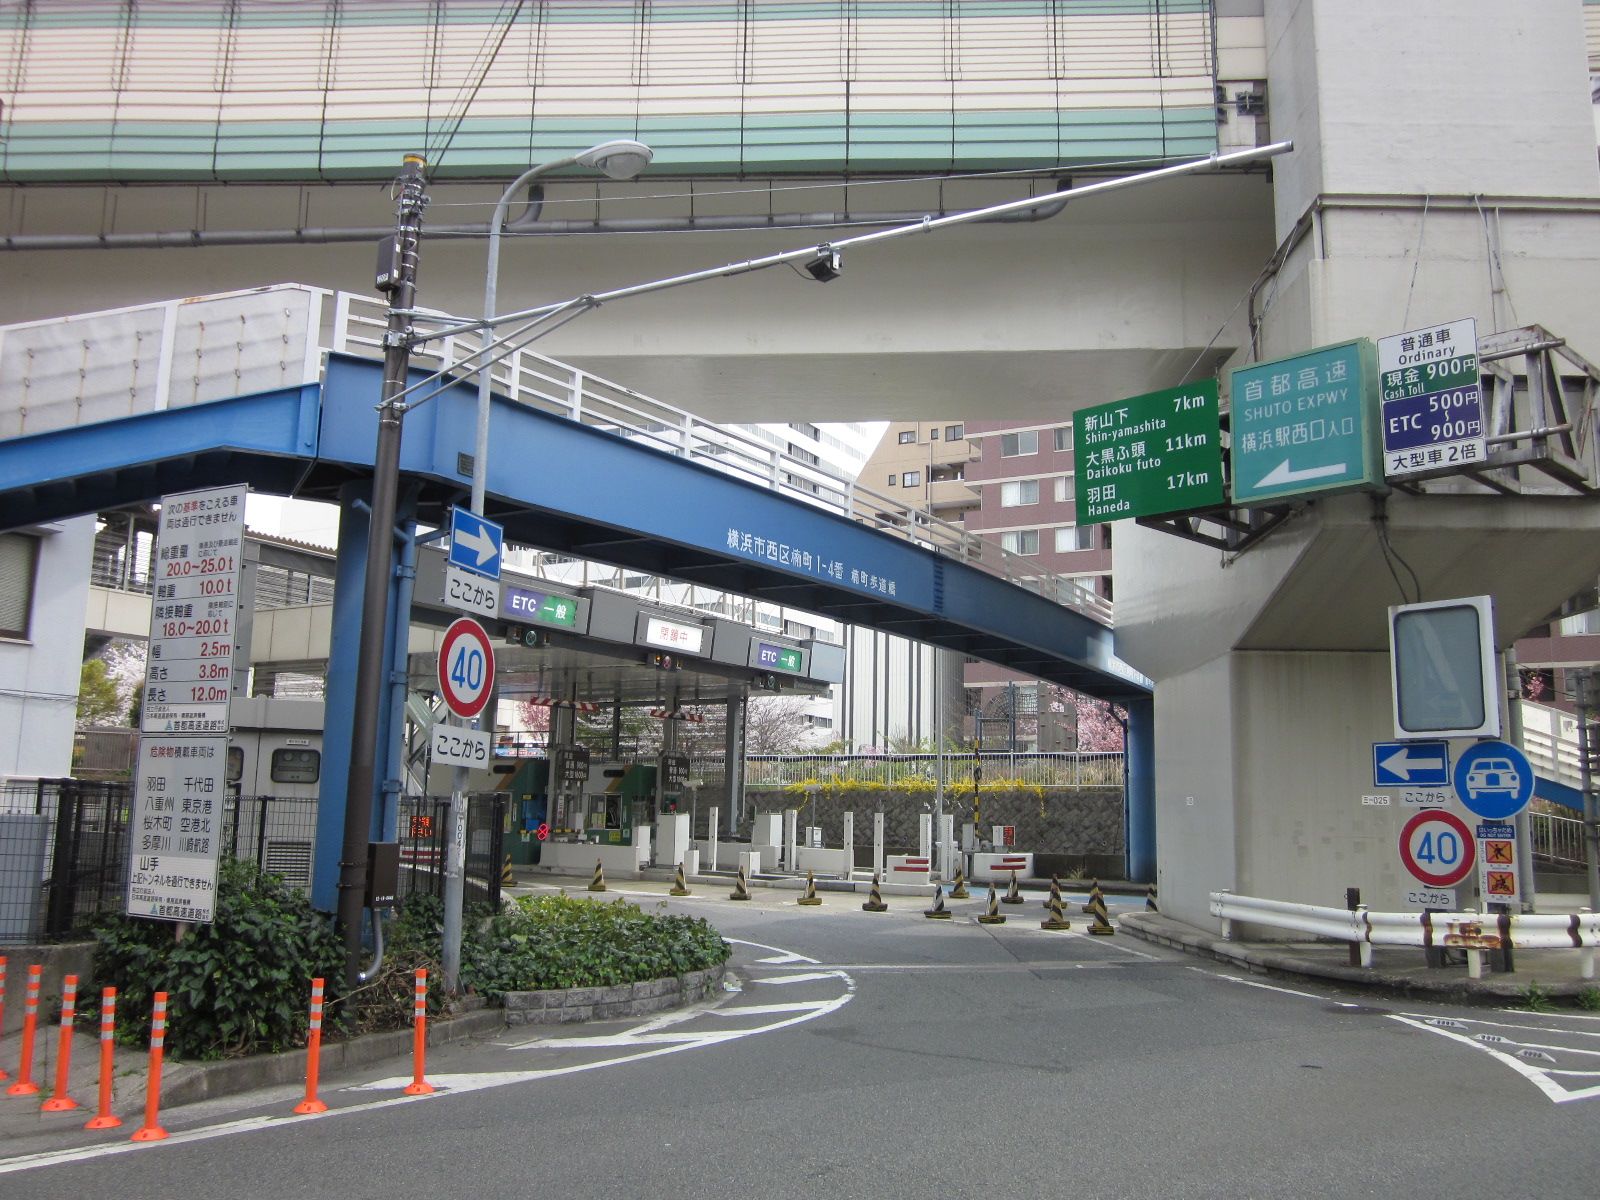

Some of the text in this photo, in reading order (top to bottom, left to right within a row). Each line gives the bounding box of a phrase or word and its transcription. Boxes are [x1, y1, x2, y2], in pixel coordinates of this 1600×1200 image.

[1401, 328, 1451, 352] 普通車
[1398, 346, 1455, 365] Ordinary
[1244, 360, 1347, 401] 首都高速
[1387, 358, 1476, 387] 現金 900円
[1384, 382, 1425, 400] Cash Toll
[1245, 388, 1348, 421] SHUTO EXPWY
[1430, 391, 1478, 412] 500円
[1085, 395, 1205, 431] 新山下 7km
[1085, 419, 1166, 445] Shin-yamashita
[1389, 413, 1421, 434] ETC
[1431, 420, 1480, 440] 900円
[1086, 433, 1206, 467] 大黒ふ頭 11km
[1087, 458, 1161, 480] Daikoku futo
[1087, 472, 1208, 503] 羽田 17km
[1088, 500, 1130, 516] Haneda
[161, 544, 189, 560] 総重量
[450, 579, 495, 609] ここから
[512, 595, 567, 620] ETC 一般
[200, 642, 230, 656] 2.5m
[761, 650, 776, 662] ETC
[149, 664, 229, 680] 高さ 3.8m
[451, 646, 482, 690] 40
[147, 687, 227, 702] 長さ 12.0m
[437, 735, 486, 761] ここから
[146, 776, 214, 792] 羽田 千代田
[181, 799, 212, 814] 東京港
[1405, 792, 1446, 803] ここから
[144, 815, 210, 833] 桜木町 空港北
[142, 835, 171, 850] 多摩川
[1416, 831, 1457, 865] 40
[139, 855, 159, 871] 山手
[1408, 892, 1450, 905] ここから
